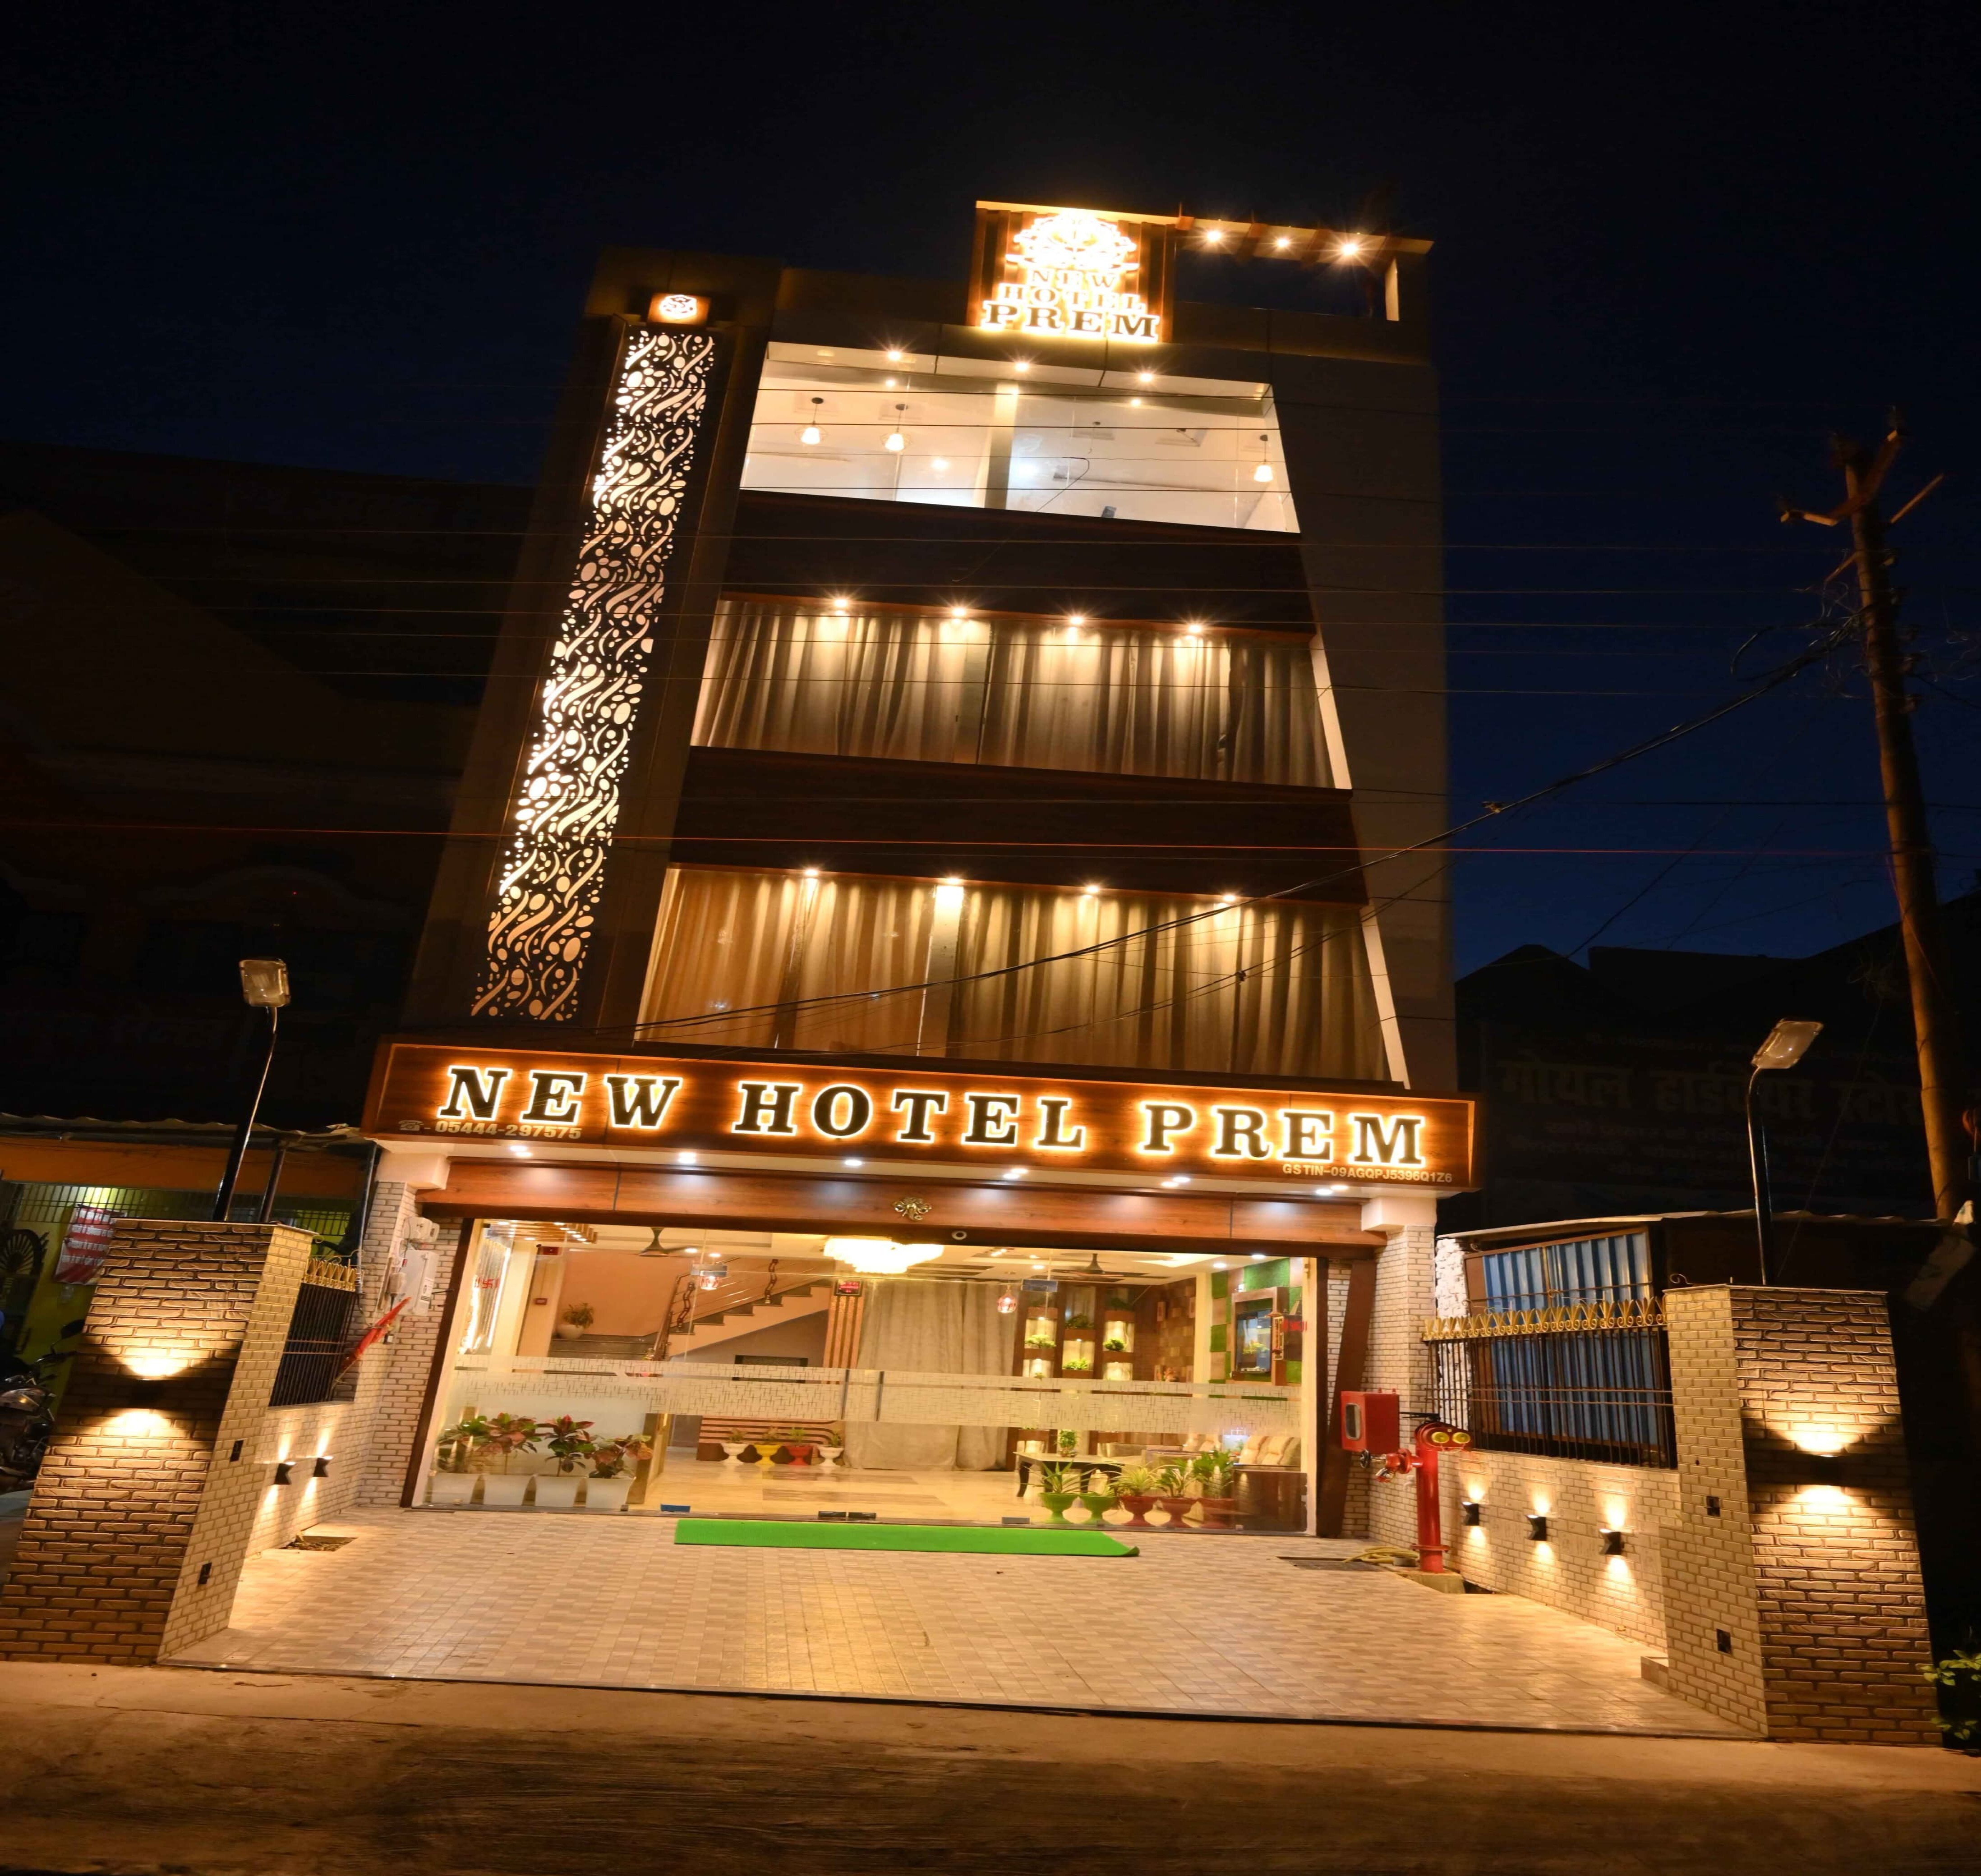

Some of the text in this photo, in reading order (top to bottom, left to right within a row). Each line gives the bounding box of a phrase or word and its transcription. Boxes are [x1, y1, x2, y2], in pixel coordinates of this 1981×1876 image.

[1030, 269, 1117, 290] NEW
[1002, 285, 1145, 311] HOTEL
[985, 303, 1157, 338] PREM
[437, 1065, 1426, 1167] NEW HOTEL PREM
[434, 1120, 582, 1140] 05444-297575
